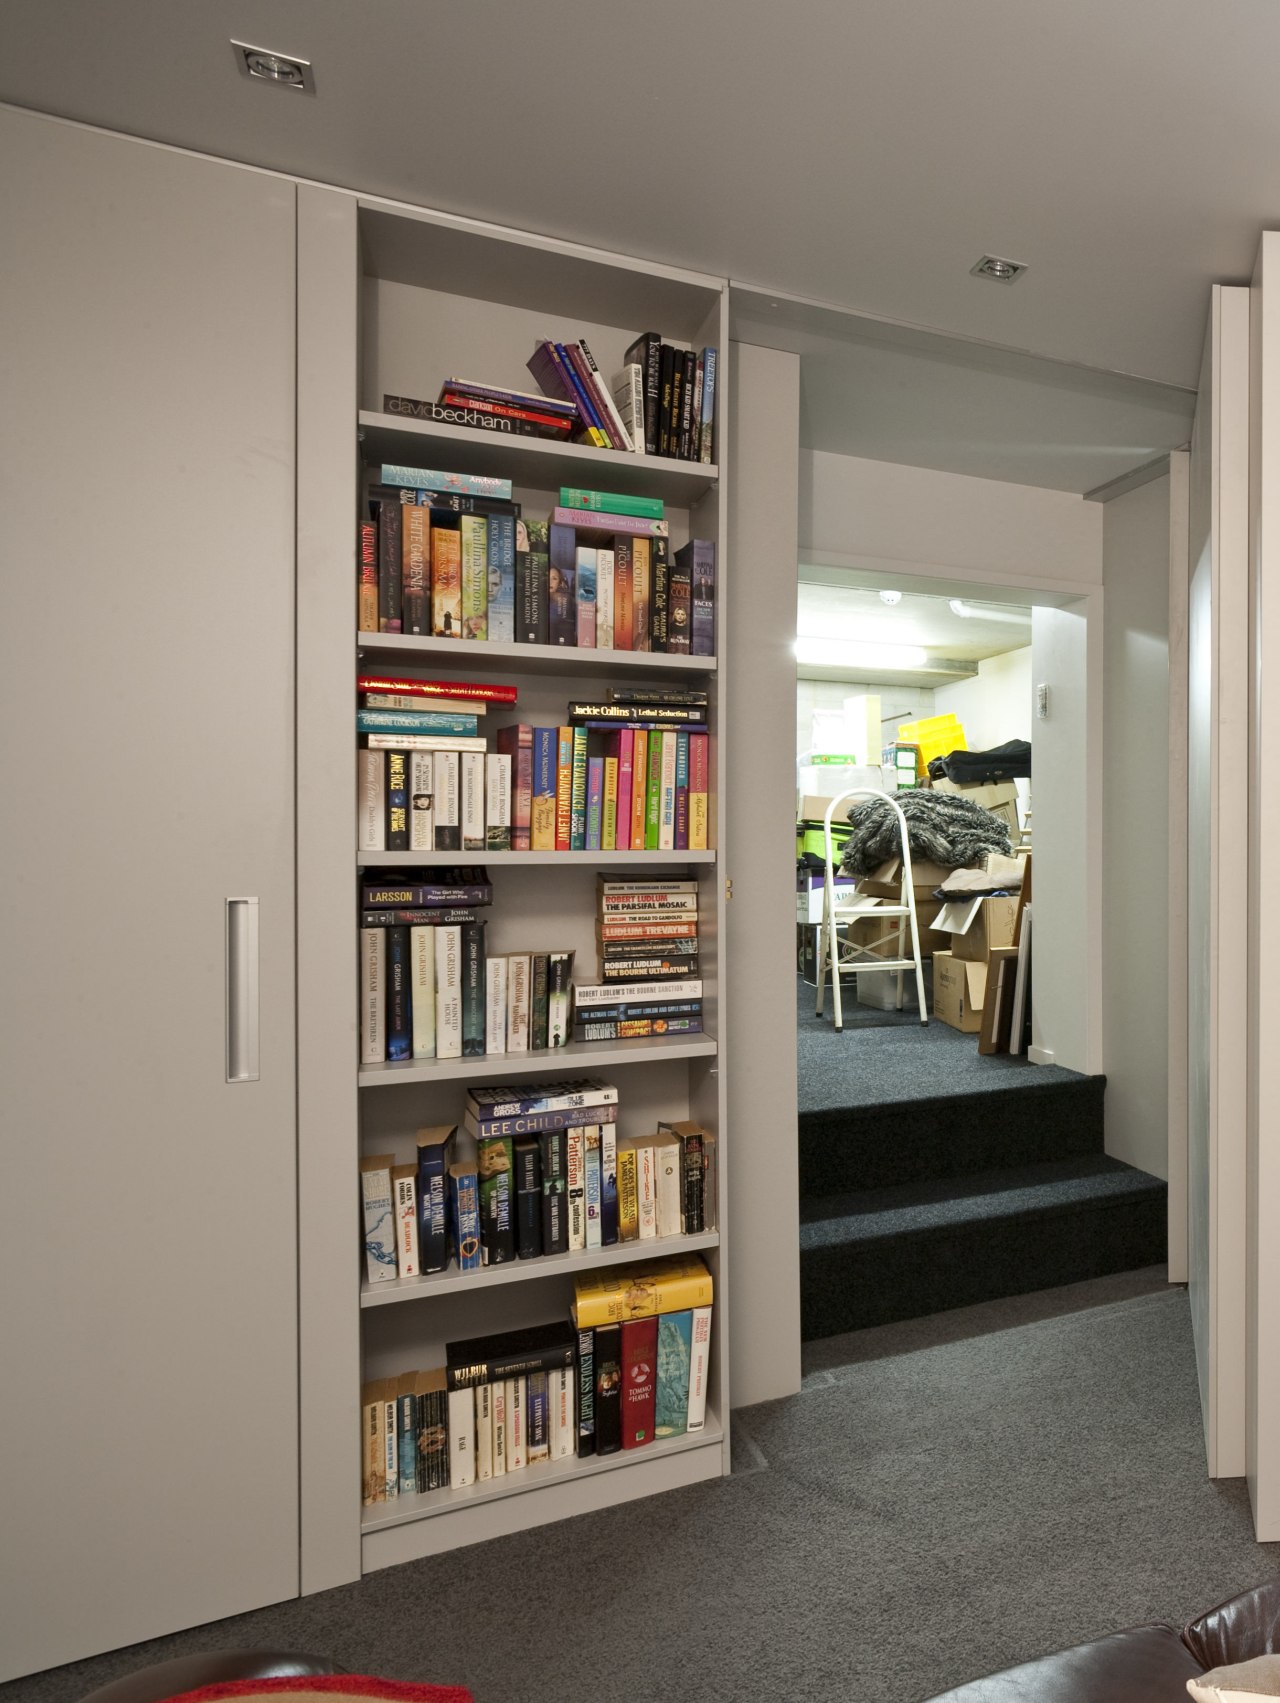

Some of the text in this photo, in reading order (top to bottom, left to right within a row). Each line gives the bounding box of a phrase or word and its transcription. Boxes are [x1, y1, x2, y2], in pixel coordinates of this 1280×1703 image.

[706, 352, 715, 392] TREETOPS
[470, 476, 502, 486] Anybody
[362, 525, 375, 564] AUTUMN
[473, 521, 486, 568] Paullina
[490, 520, 499, 540] HOLY
[411, 510, 424, 591] WHITE GARDENIA
[618, 545, 626, 586] PICOULT
[634, 551, 642, 595] PICOULT
[656, 563, 666, 591] Martina
[573, 705, 600, 715] Jackie
[601, 706, 629, 716] Collins
[390, 754, 405, 790] ANNE RICE
[572, 735, 586, 810] JANET EVANOVICH
[558, 770, 570, 843] JANET EVANOVICH
[370, 892, 412, 902] LARSSON
[638, 894, 668, 902] LUDLUM
[606, 925, 689, 936] LUDLUM TREVAYNE
[369, 933, 378, 992] JOHN GRISHAM
[418, 934, 427, 986] JOHN GRISHAM
[446, 931, 456, 987] JOHN GRISHAM
[633, 960, 661, 968] LUDLUM
[515, 977, 524, 1003] GRISHAM
[585, 1028, 616, 1040] LUDLUM'S
[621, 1028, 651, 1037] COMPACT
[482, 1116, 564, 1136] LEE CHILD
[568, 1136, 581, 1186] Patterson
[587, 1169, 599, 1204] PATTERSON
[431, 1176, 445, 1235] NELSON DEMILLE
[497, 1173, 509, 1231] NELSON DEMILLE
[551, 1217, 559, 1241] LUSTBADER
[572, 1205, 581, 1235] confession
[455, 1365, 487, 1379] WILBUR
[495, 1396, 504, 1407] Cry
[581, 1356, 593, 1420] ENDLESS NIGHT
[629, 1385, 651, 1396] TOMMO
[496, 1408, 505, 1424] Wolf
[458, 1436, 466, 1452] RAGE
